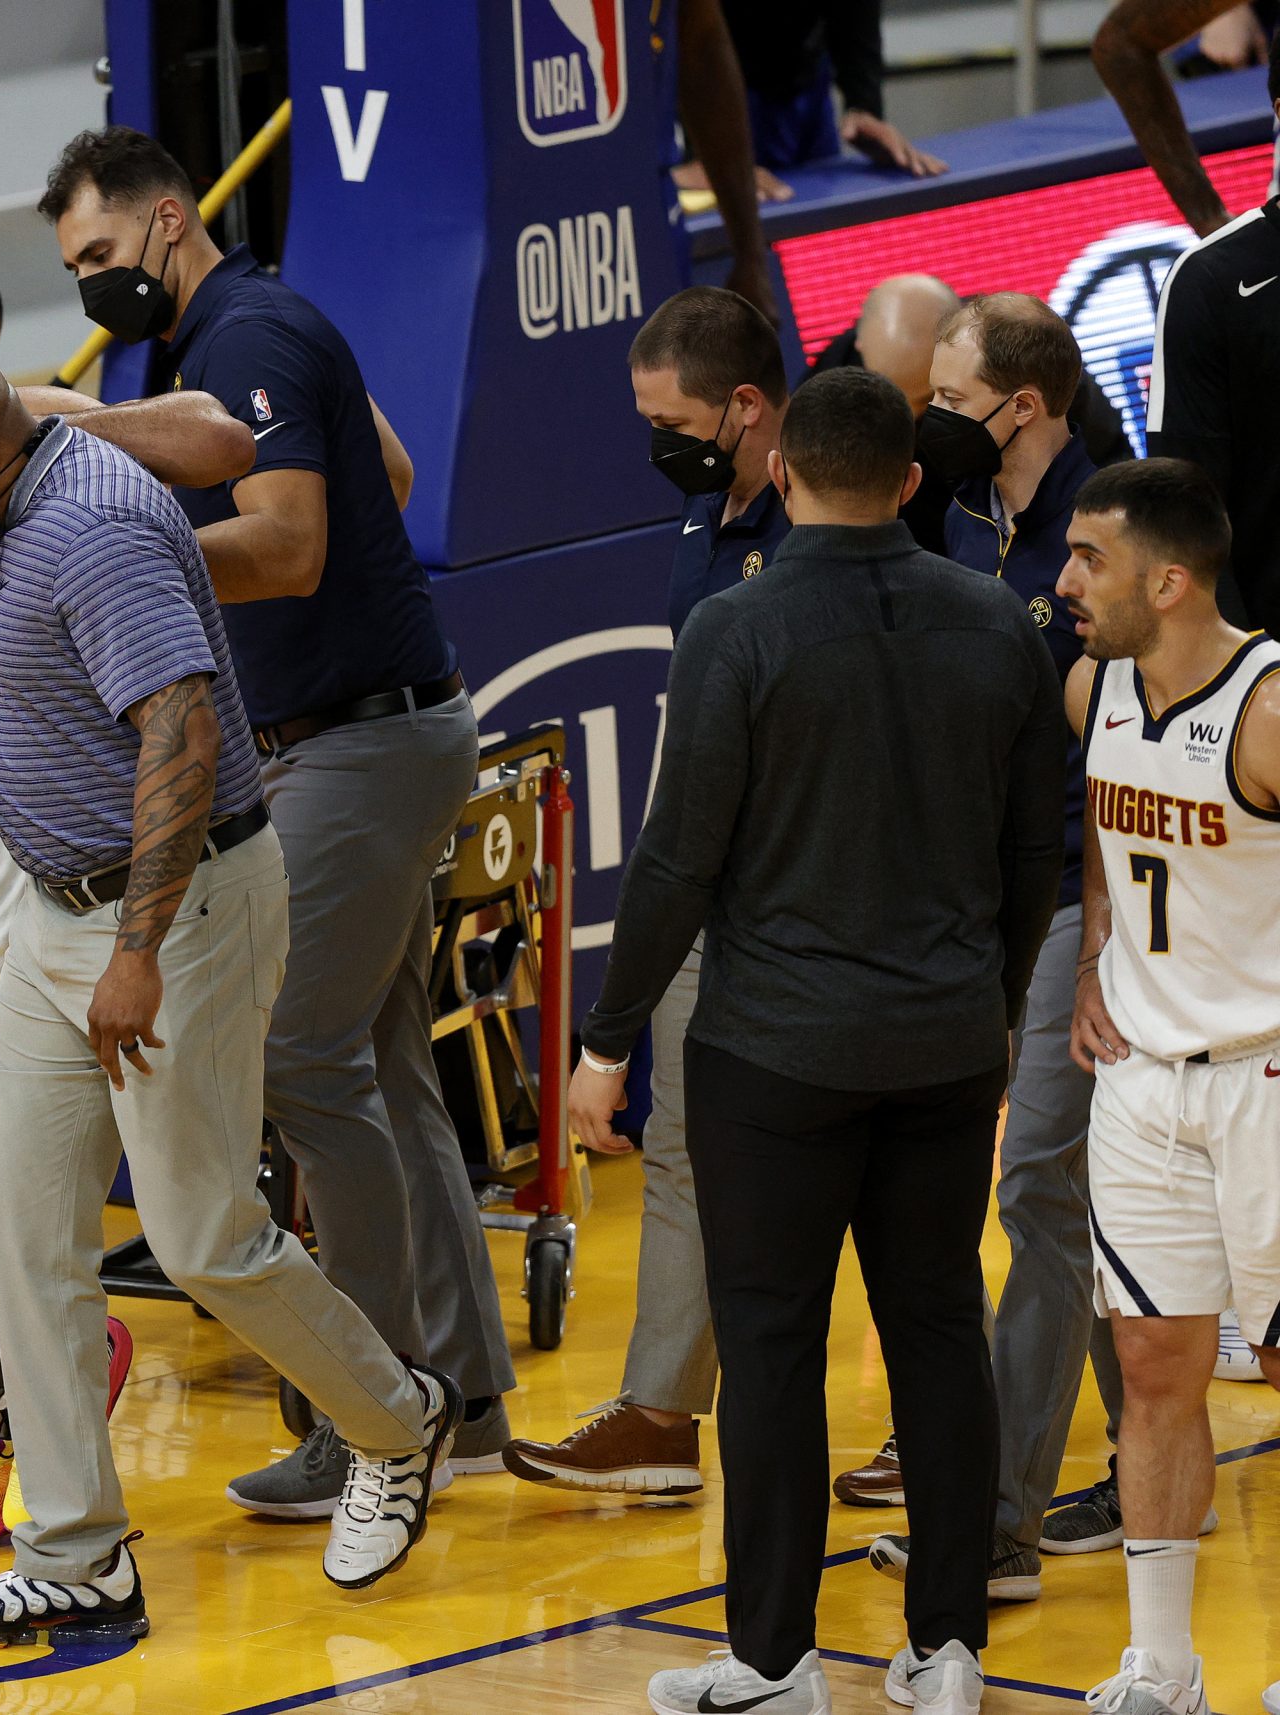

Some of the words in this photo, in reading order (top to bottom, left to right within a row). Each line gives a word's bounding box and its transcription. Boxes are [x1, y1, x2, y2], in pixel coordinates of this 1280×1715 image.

[532, 52, 586, 120] NBA
[516, 205, 643, 340] @NBA
[1185, 742, 1217, 755] Western
[1190, 721, 1223, 744] WU
[1188, 753, 1210, 764] Union
[1129, 850, 1170, 954] 7
